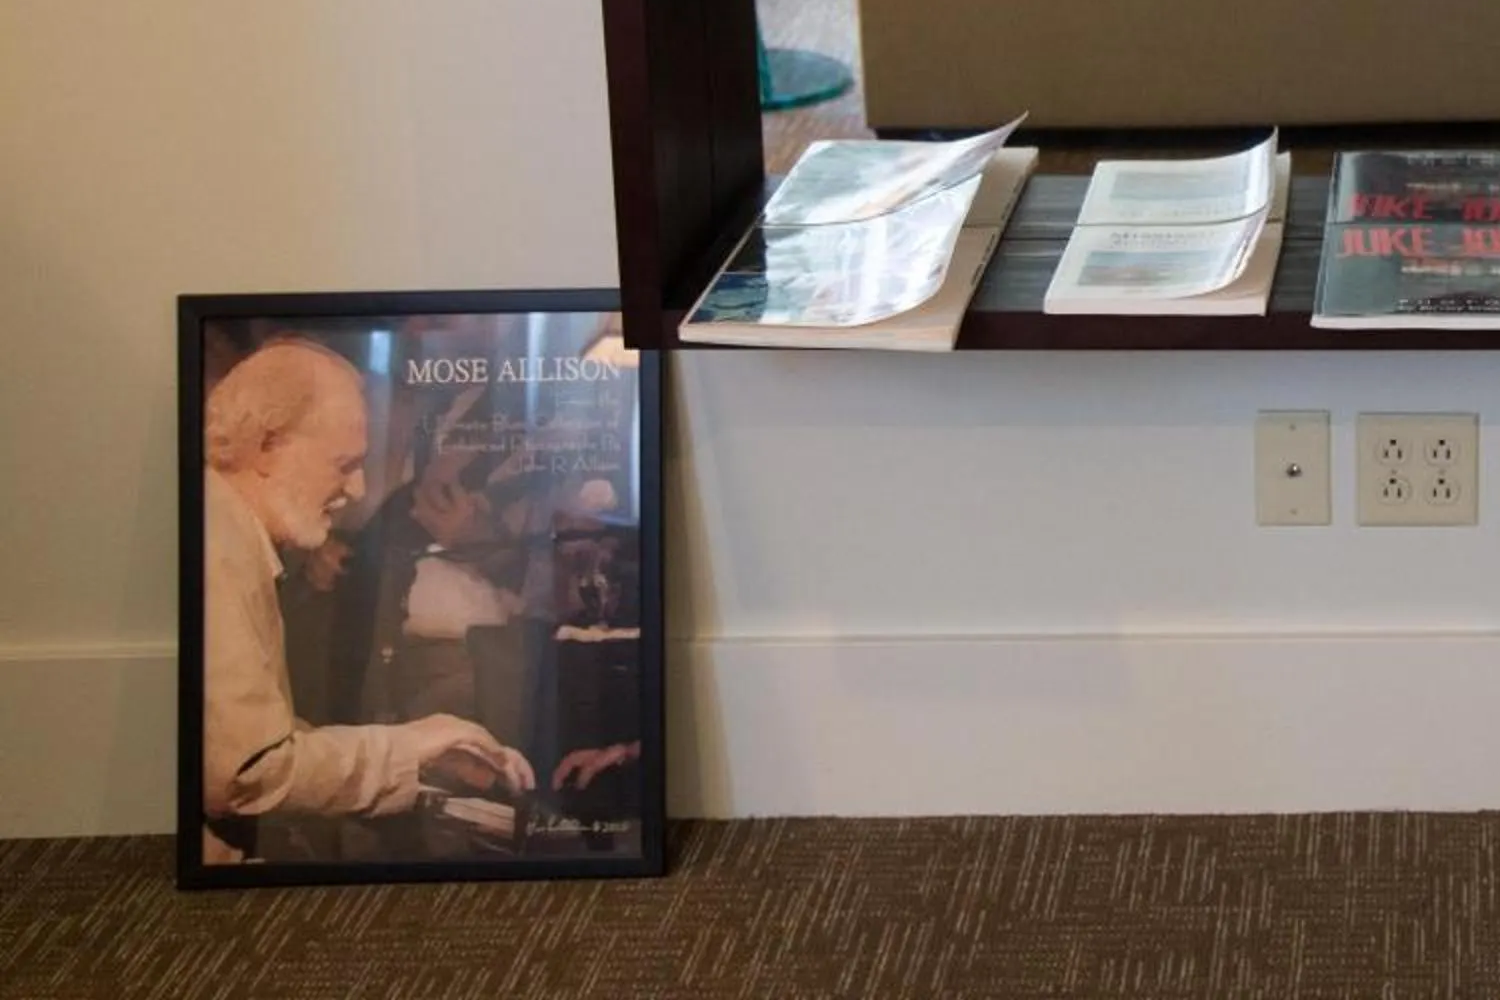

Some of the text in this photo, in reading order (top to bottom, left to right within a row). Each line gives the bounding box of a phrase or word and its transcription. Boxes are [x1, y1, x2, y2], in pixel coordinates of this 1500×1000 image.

[1338, 227, 1433, 257] JUKE
[407, 357, 622, 384] MOSE ALLISON
